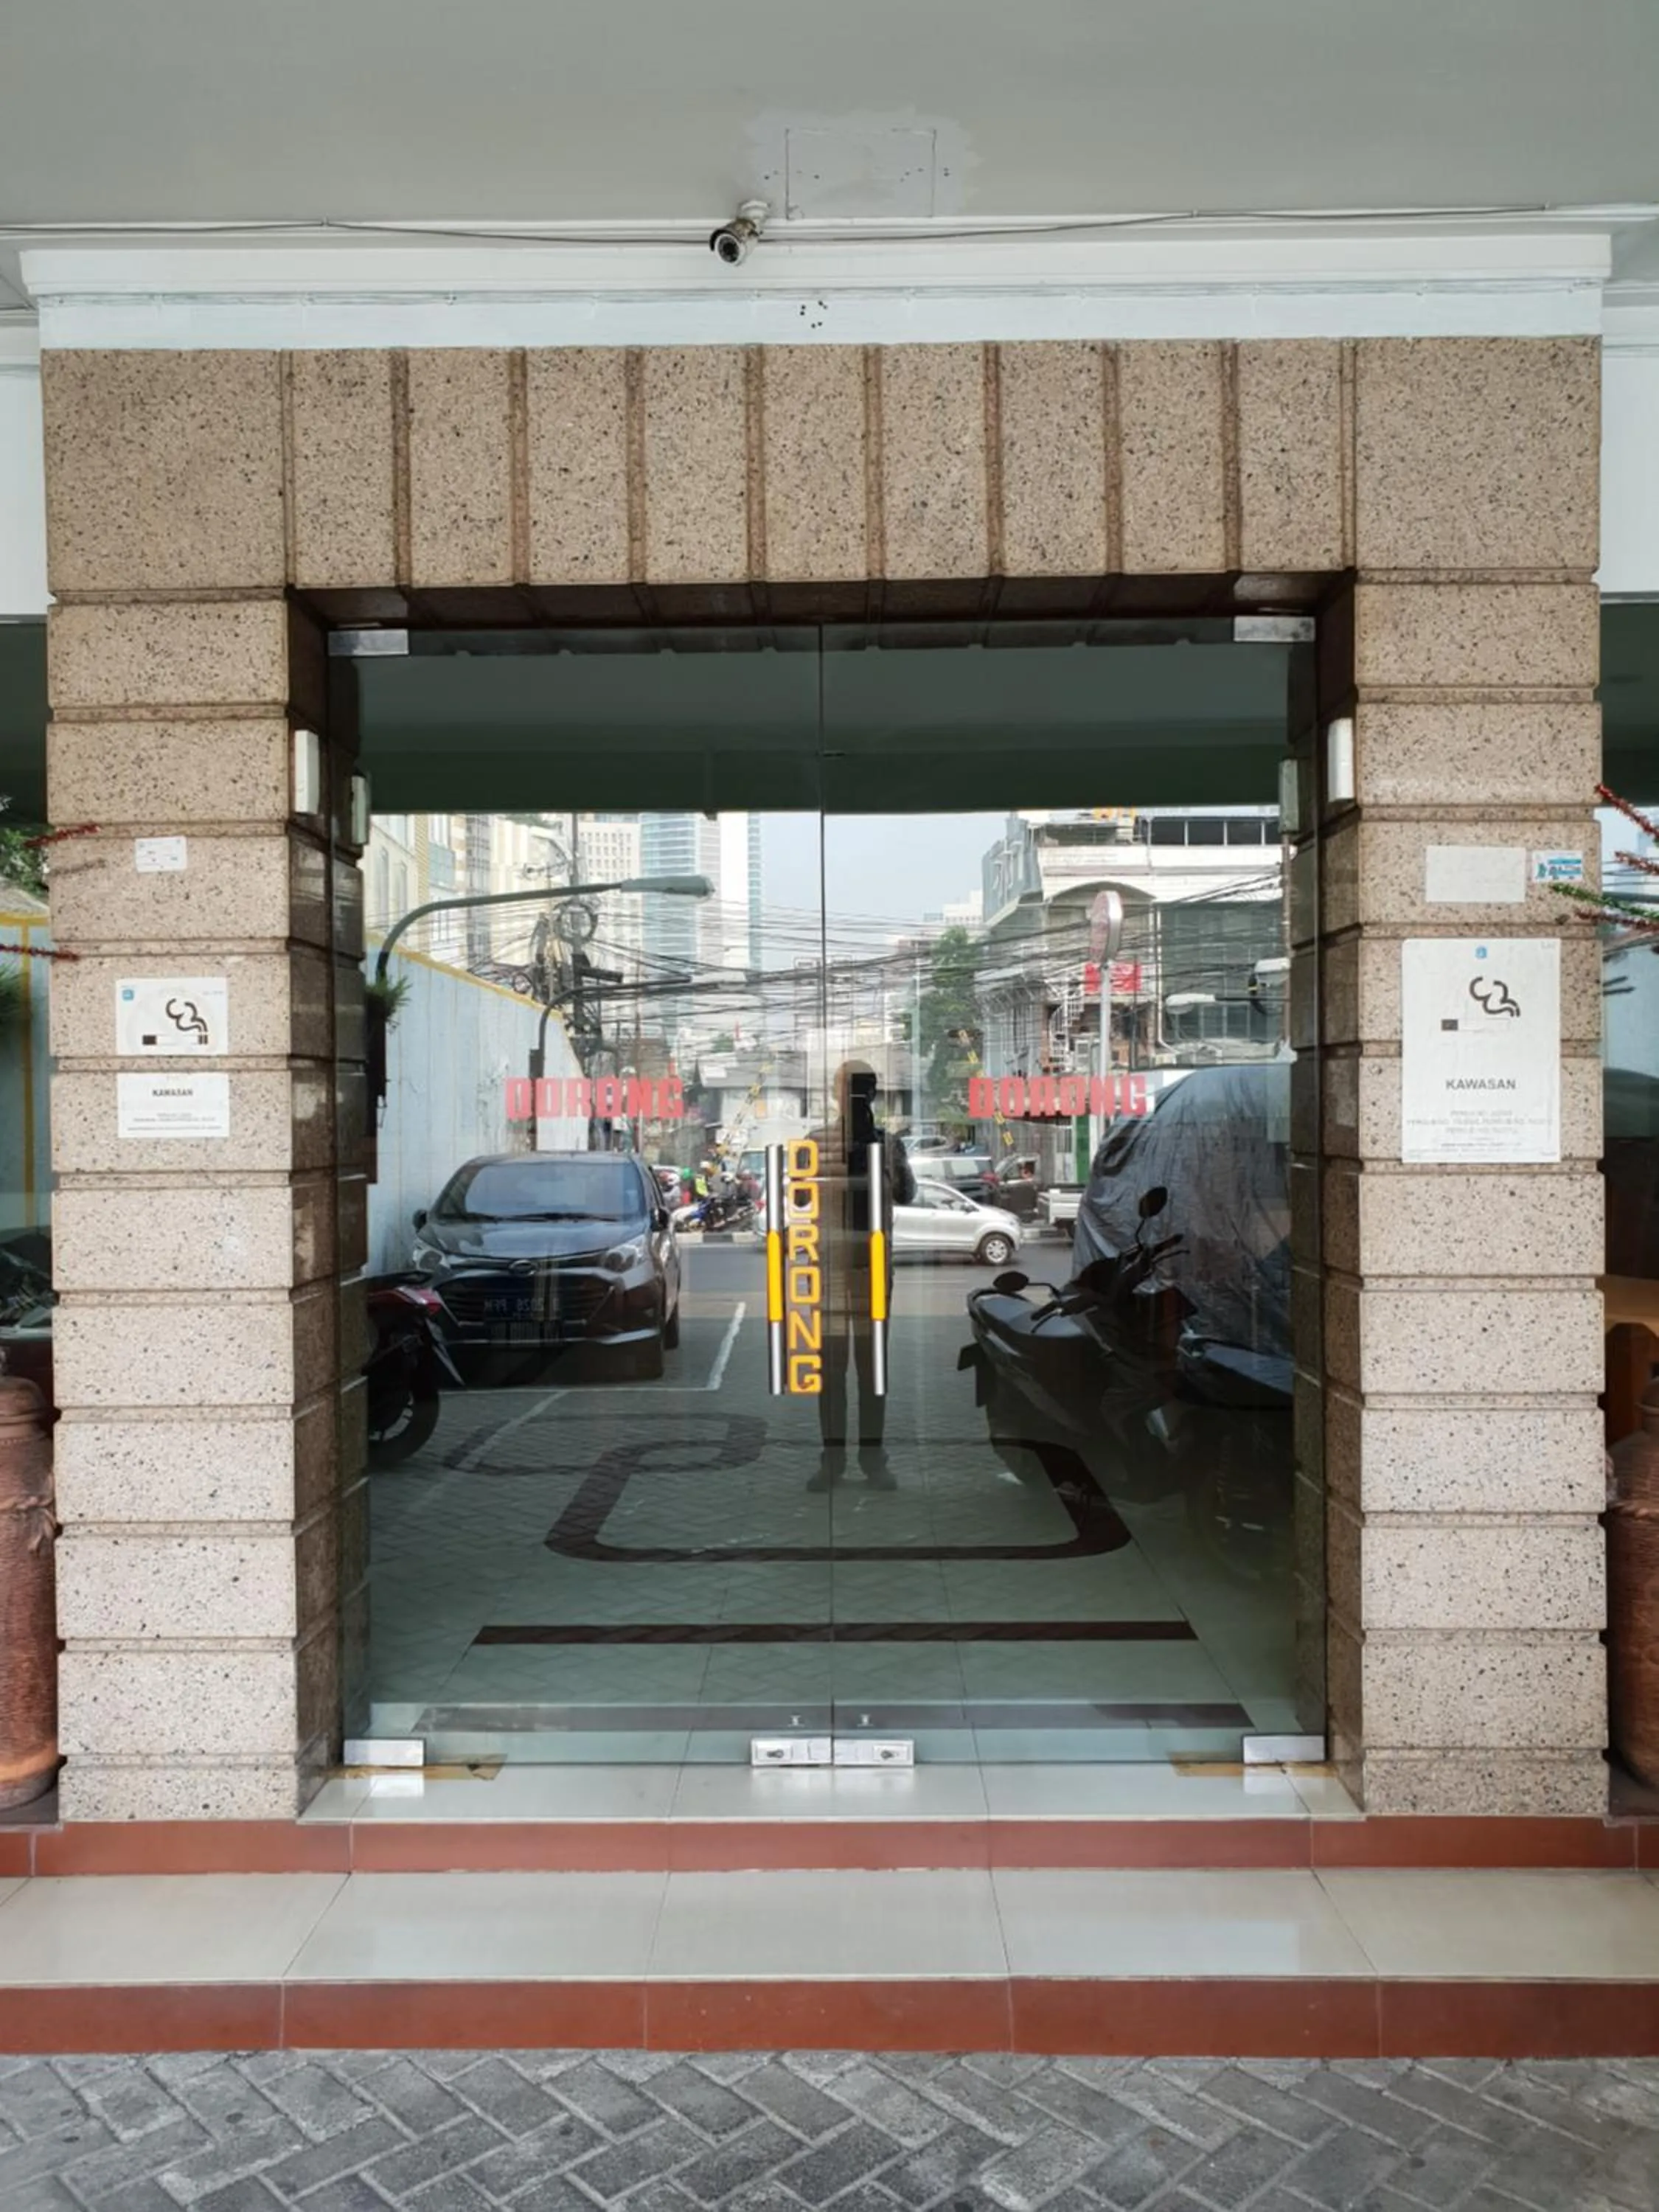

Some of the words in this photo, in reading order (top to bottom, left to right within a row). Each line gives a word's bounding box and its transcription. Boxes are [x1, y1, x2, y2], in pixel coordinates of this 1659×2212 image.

[506, 1077, 684, 1119] DORONG
[968, 1077, 1148, 1118] DORONG
[1446, 1079, 1517, 1090] KAWASAN
[787, 1139, 822, 1393] DORONG
